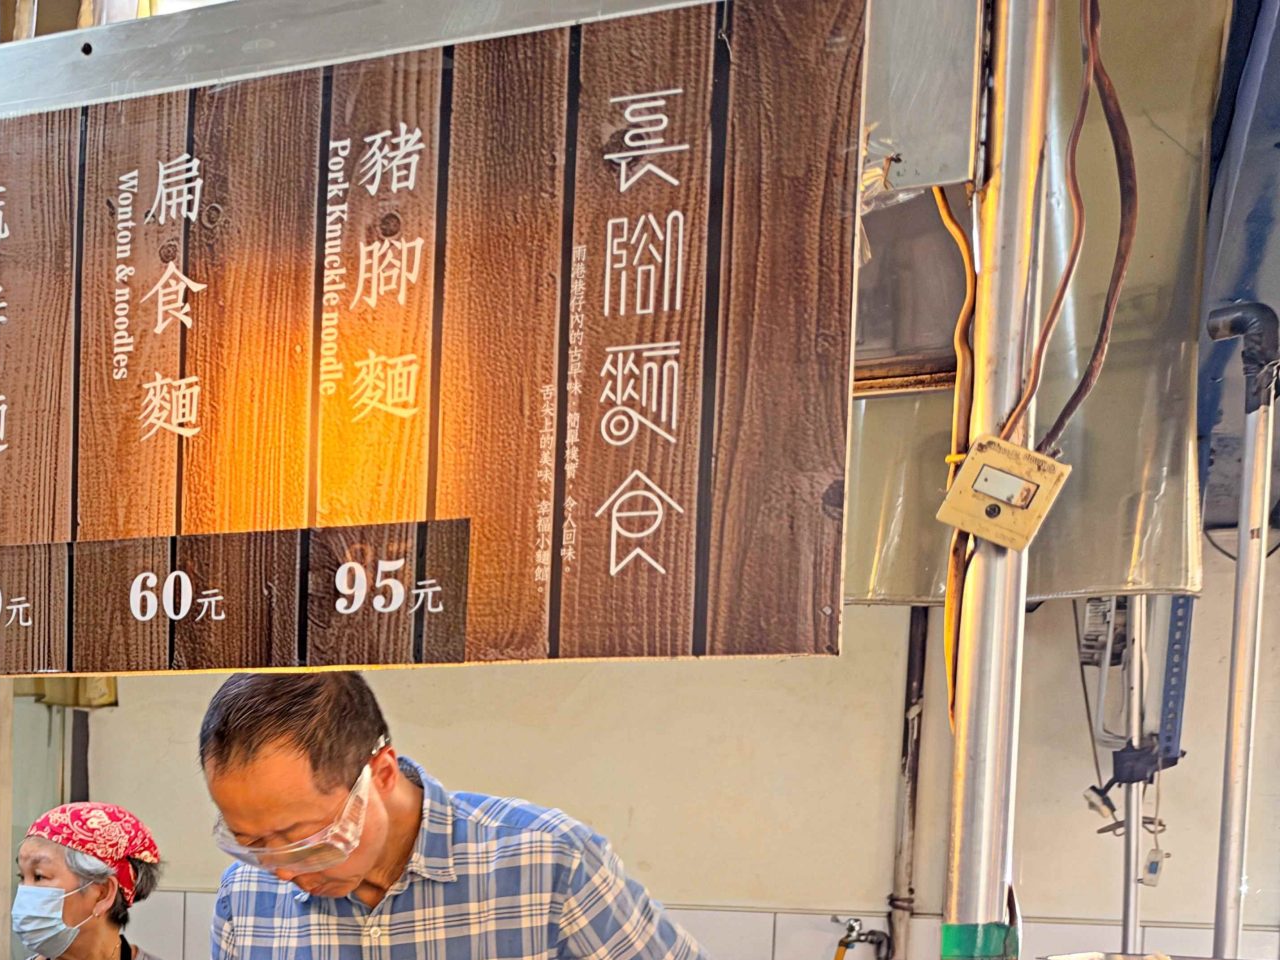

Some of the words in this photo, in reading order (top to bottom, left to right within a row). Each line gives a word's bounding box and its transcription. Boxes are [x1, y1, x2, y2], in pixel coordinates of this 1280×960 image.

[327, 138, 351, 199] Pork
[116, 168, 139, 259] Wonton
[322, 202, 349, 307] Knuckle
[114, 263, 136, 283] &
[138, 152, 208, 443] 扁食麵
[349, 121, 426, 424] 豬腳麵
[112, 287, 134, 381] noodles
[318, 311, 345, 396] noodle
[129, 570, 226, 622] 60元
[335, 558, 444, 615] 95元
